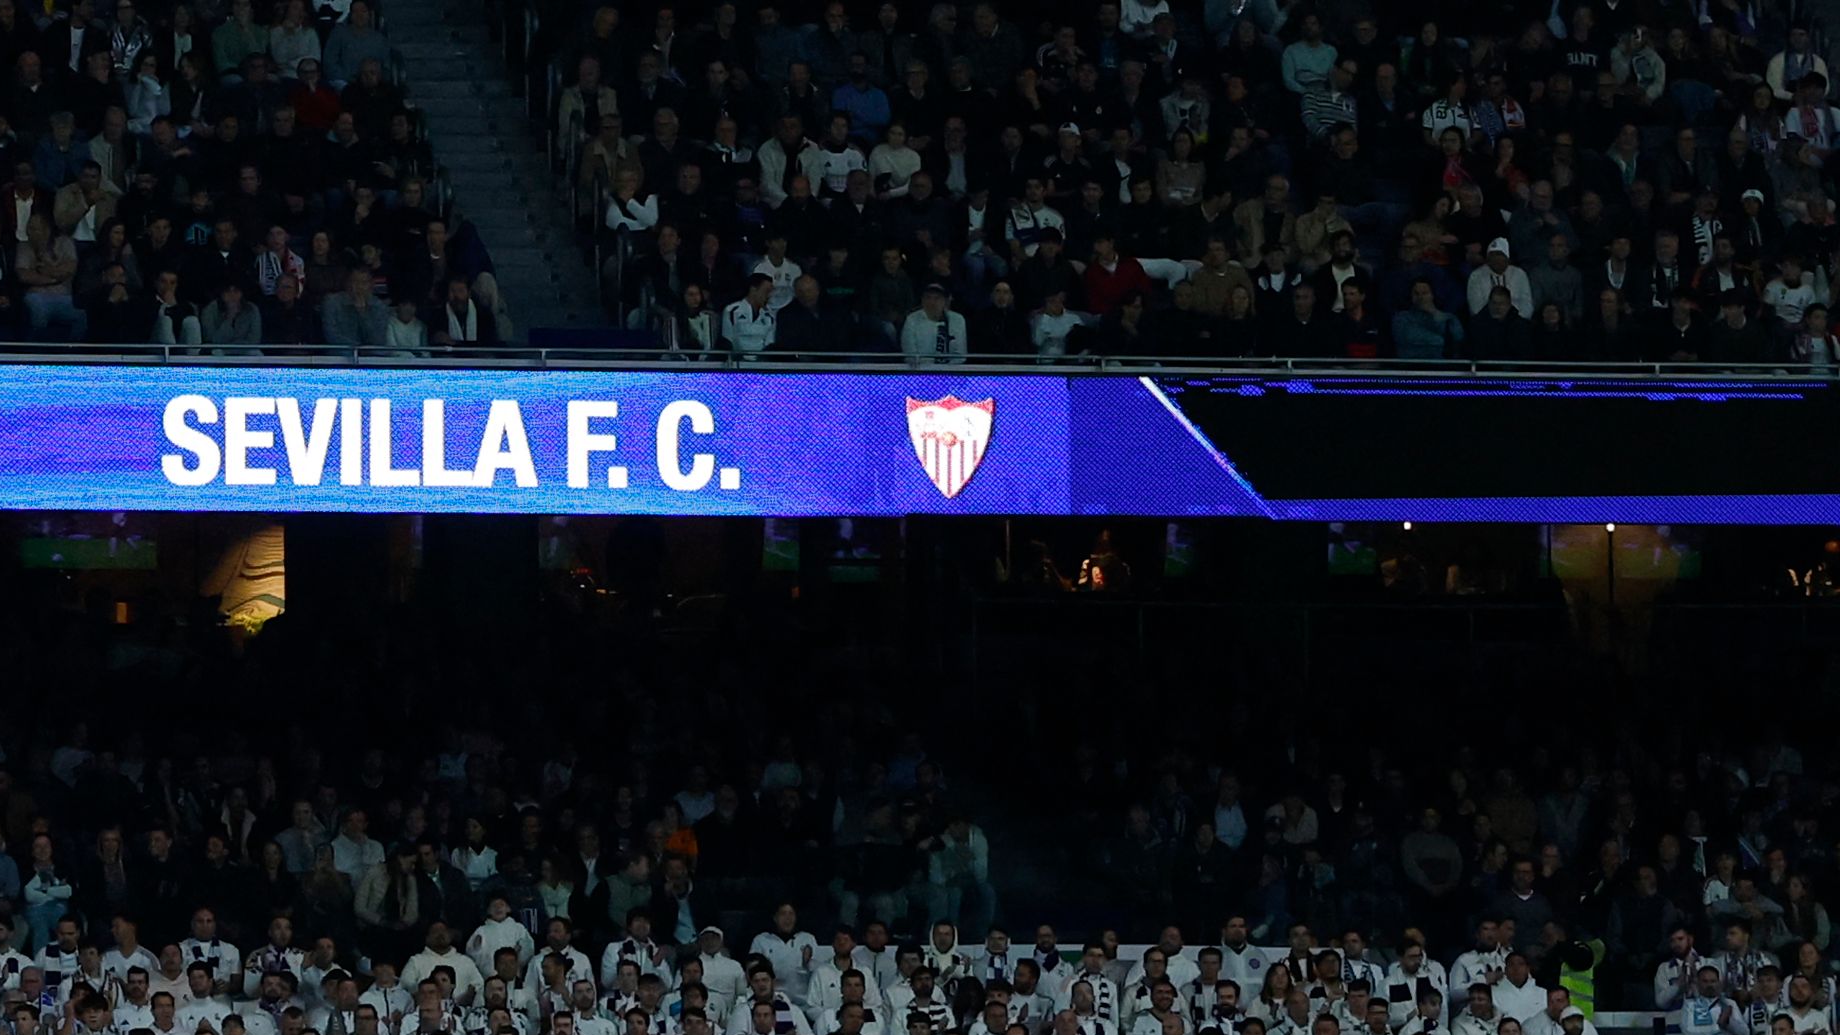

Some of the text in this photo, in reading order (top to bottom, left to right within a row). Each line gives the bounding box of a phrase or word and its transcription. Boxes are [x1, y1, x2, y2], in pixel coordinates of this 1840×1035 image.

[161, 395, 741, 491] SEVILLA F. C.
